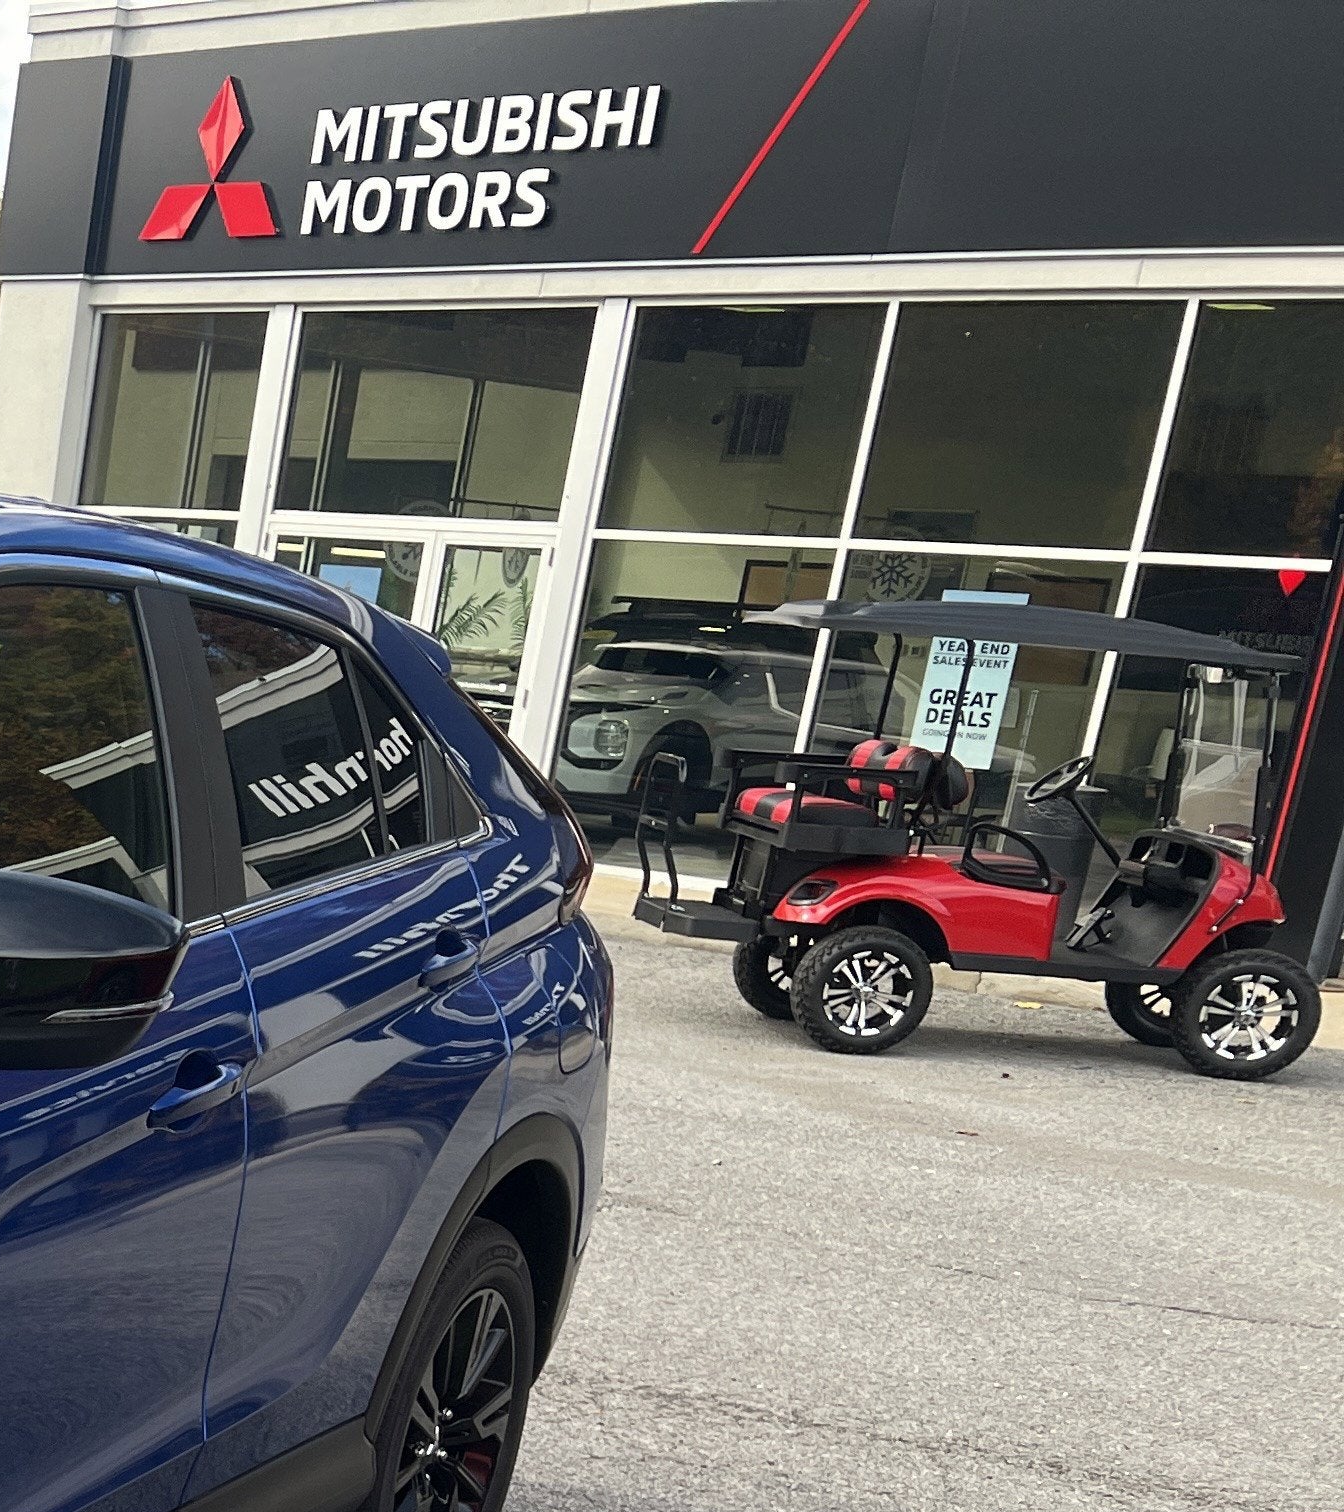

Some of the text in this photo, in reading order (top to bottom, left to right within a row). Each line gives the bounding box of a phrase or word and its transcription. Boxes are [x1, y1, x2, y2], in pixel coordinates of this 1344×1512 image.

[311, 85, 662, 165] MITSUBISHI
[300, 167, 550, 237] MOTORS
[938, 639, 1010, 655] YEA END
[929, 688, 998, 709] GREAT
[925, 708, 992, 728] DEALS
